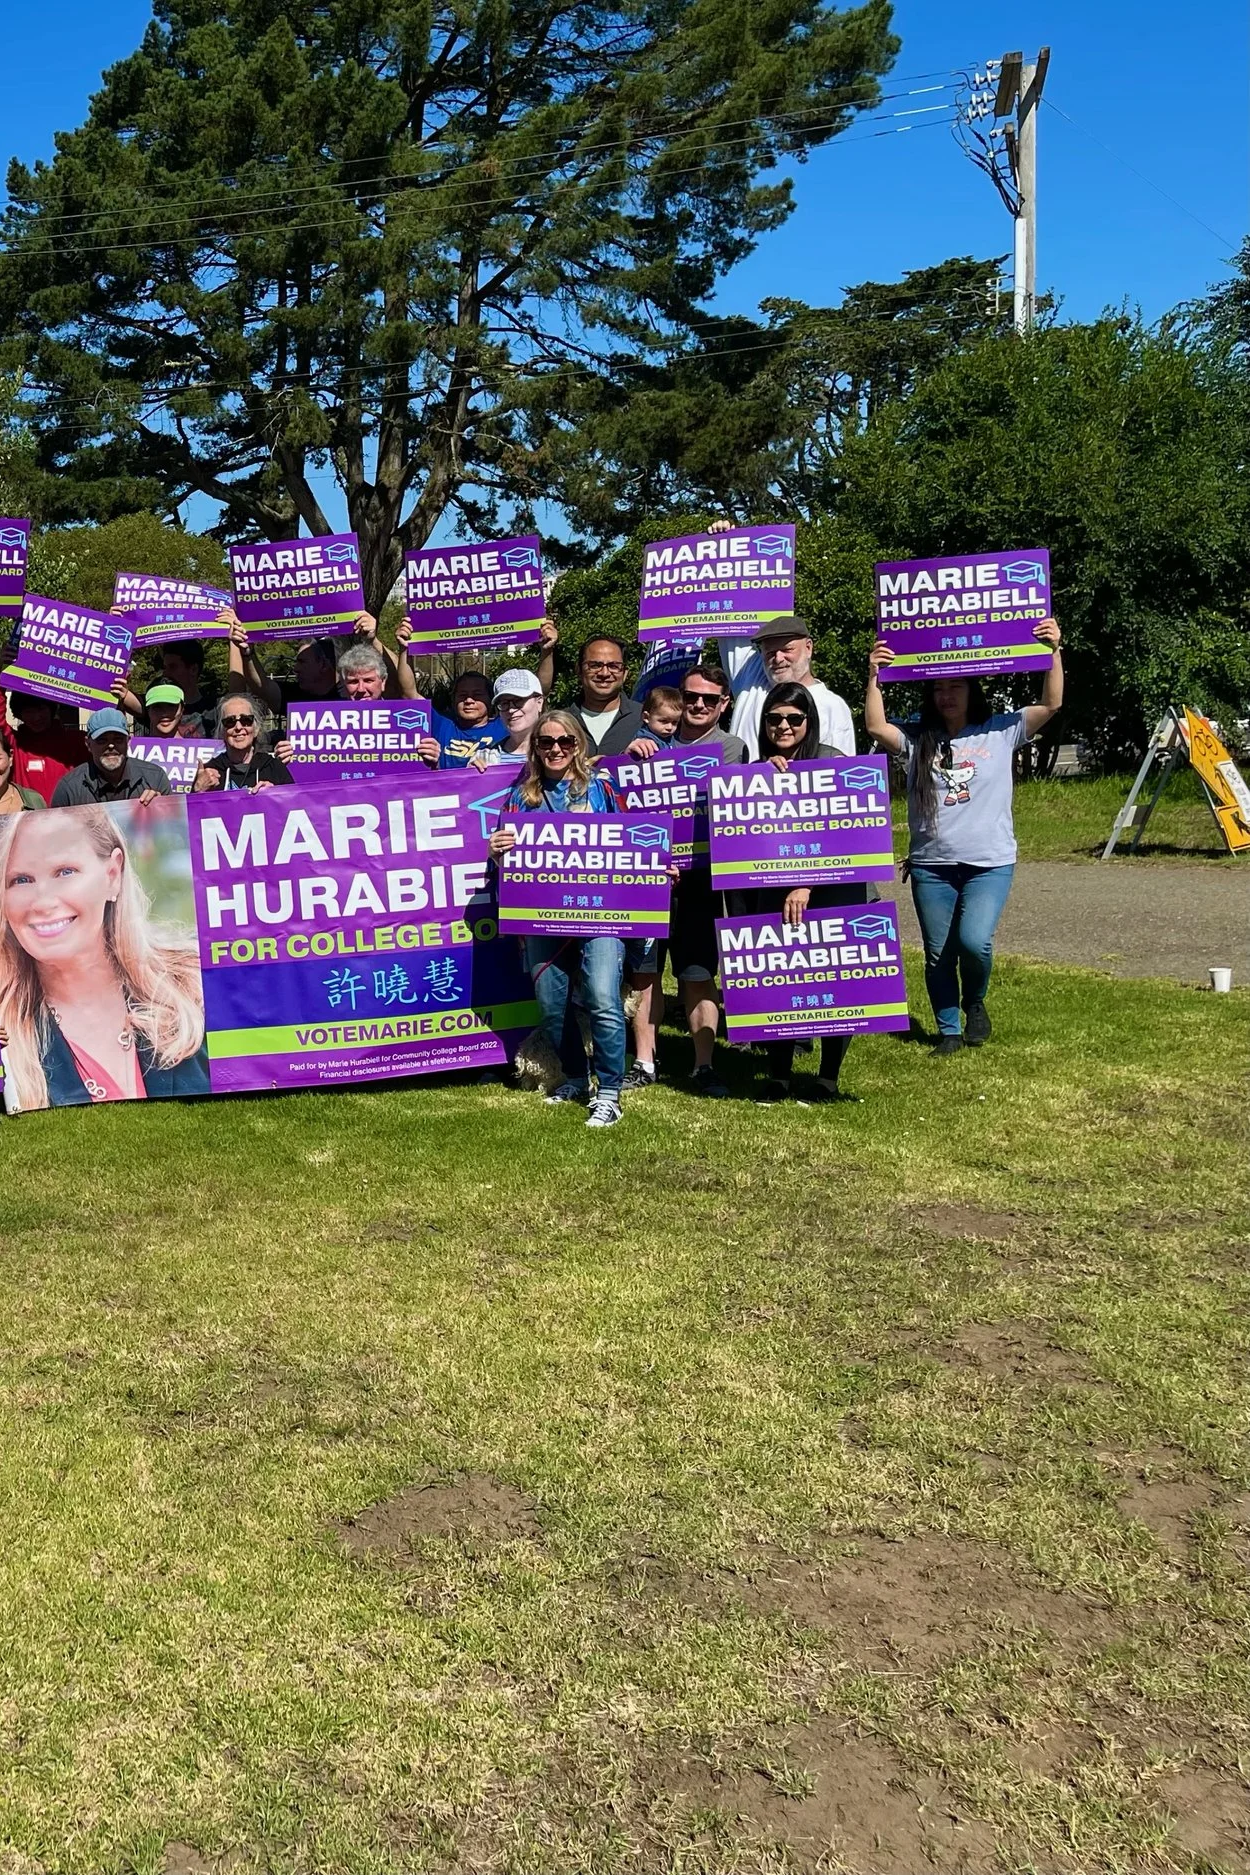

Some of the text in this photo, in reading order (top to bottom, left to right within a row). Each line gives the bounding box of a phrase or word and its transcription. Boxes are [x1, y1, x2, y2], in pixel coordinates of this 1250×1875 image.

[233, 546, 323, 572] MARIE
[646, 537, 750, 569] MARIE
[236, 565, 358, 590] HURABIELL
[406, 552, 500, 581] MARIE
[645, 554, 792, 587] HURABIELL
[118, 577, 202, 595] MARIE
[409, 570, 539, 598] HURABIELL
[880, 564, 999, 596] MARIE
[116, 591, 230, 608] HURABIELL
[881, 587, 1045, 618] HURABIELL
[23, 602, 103, 638] MARIE
[265, 616, 336, 628] VOTEMARIE.COM
[438, 624, 514, 638] VOTEMARIE.COM
[673, 614, 757, 624] VOTEMARIE.COM
[882, 607, 1046, 631] FOR COLLEGE BOARD
[916, 649, 1011, 663] VOTEMARIE.COM
[28, 674, 92, 694] VOTEMARIE.COM
[290, 710, 390, 730] MARIE
[617, 760, 677, 788] RIE
[712, 769, 836, 799] MARIE
[713, 794, 886, 822] HURABIELL
[200, 794, 464, 871] MARIE
[504, 823, 623, 846] MARIE
[714, 816, 887, 837] FOR COLLEGE BOARD
[502, 850, 667, 870] HURABIELL
[753, 858, 851, 870] VOTEMARIE.COM
[504, 873, 667, 884] FOR COLLEGE BOARD
[206, 862, 490, 928] HURABIE
[537, 911, 630, 920] VOTEMARIE.COM
[211, 938, 278, 964] FOR
[287, 921, 443, 958] COLLEGE
[721, 918, 846, 951] MARIE
[724, 943, 897, 974] HURABIELL
[322, 957, 463, 1010] 許曉慧
[726, 966, 899, 989] FOR COLLEGE BOARD
[767, 1008, 865, 1022] VOTEMARIE.COM
[295, 1011, 493, 1046] VOTEMARIE.COM
[306, 1062, 316, 1070] for
[318, 1062, 328, 1070] by
[328, 1060, 348, 1068] Marie
[350, 1056, 380, 1066] Hurabiell
[392, 1050, 430, 1060] Community
[432, 1046, 457, 1056] College
[458, 1044, 478, 1052] Board
[480, 1041, 500, 1050] 2022.
[320, 1070, 350, 1078] Financial
[352, 1065, 390, 1076] disclosures
[392, 1060, 420, 1070] available
